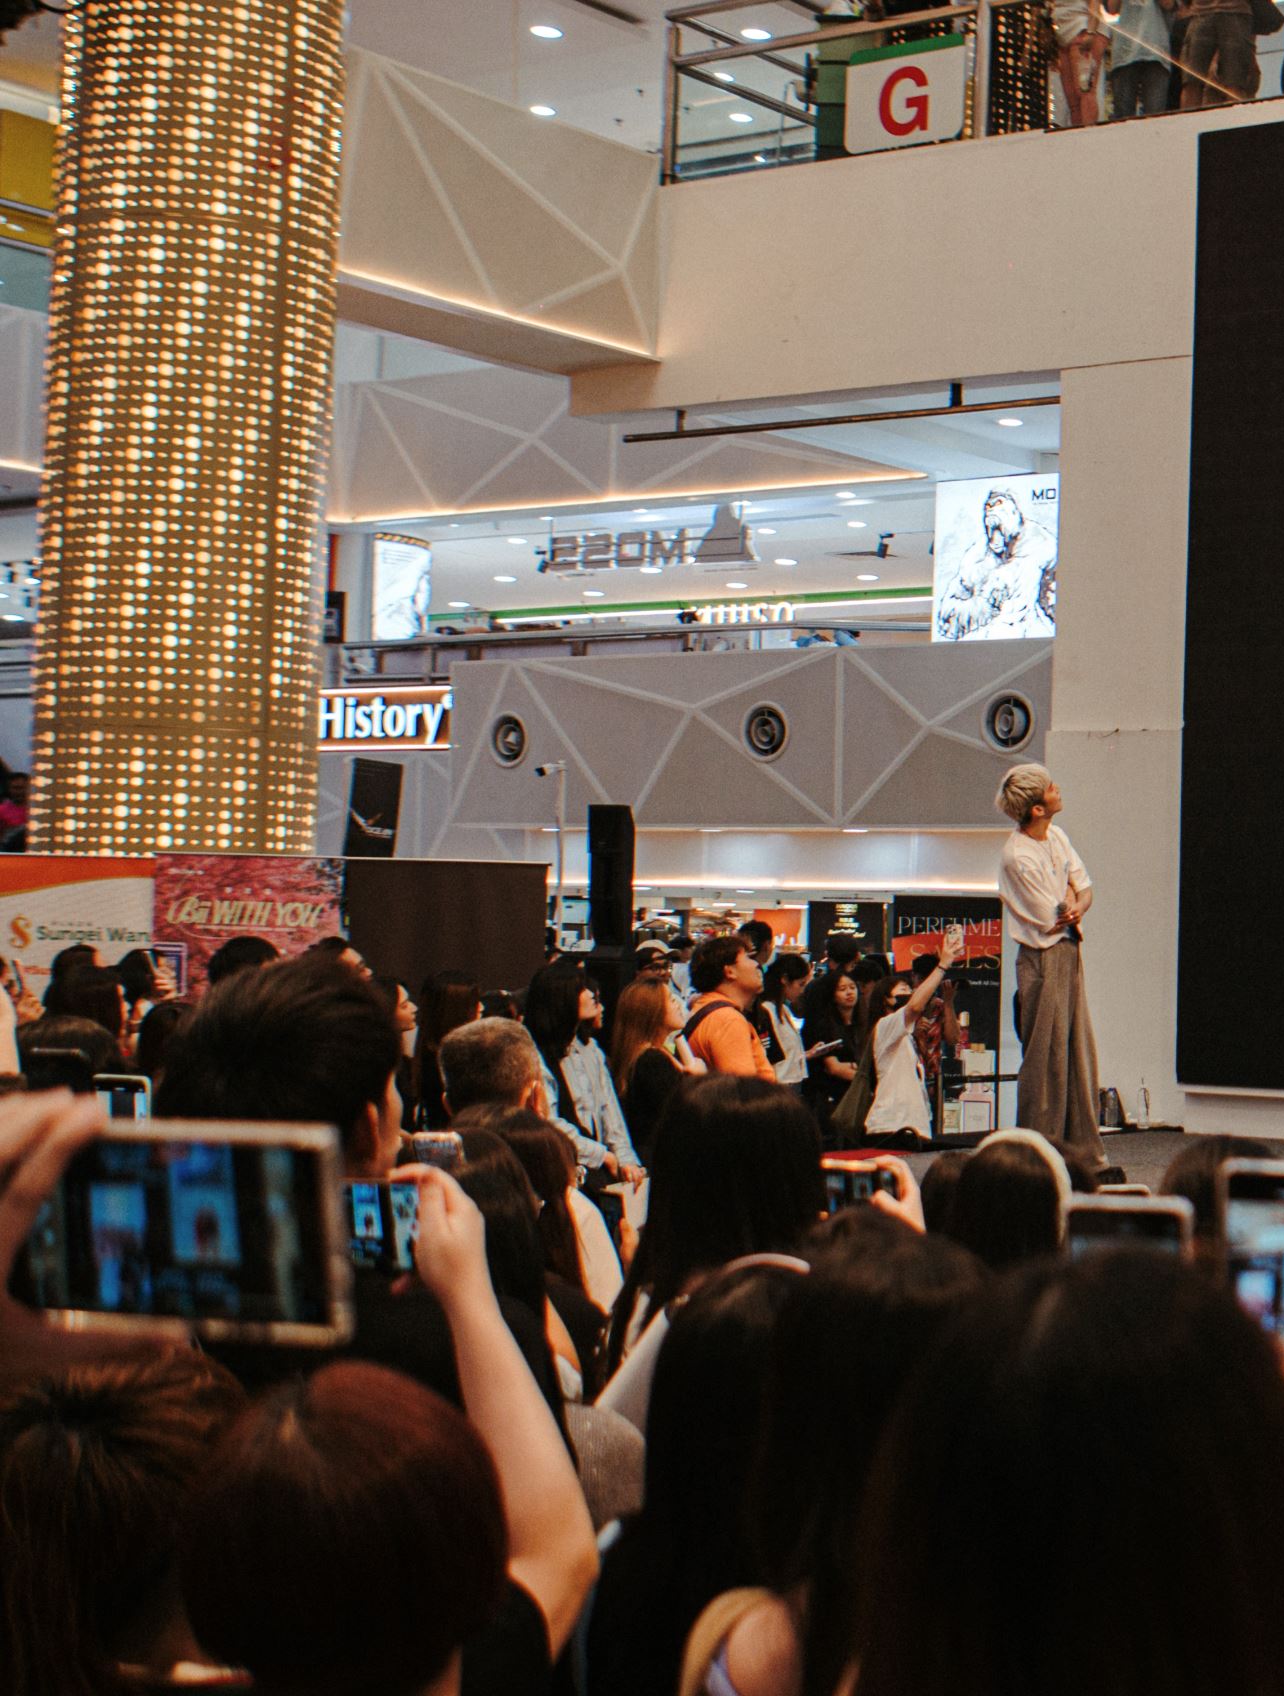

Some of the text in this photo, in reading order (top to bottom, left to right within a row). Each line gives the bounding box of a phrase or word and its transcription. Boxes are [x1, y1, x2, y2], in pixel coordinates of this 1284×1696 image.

[880, 66, 931, 136] G
[318, 695, 445, 746] History
[212, 899, 272, 925] WITH
[276, 901, 325, 928] YOU
[36, 926, 102, 945] Sungei
